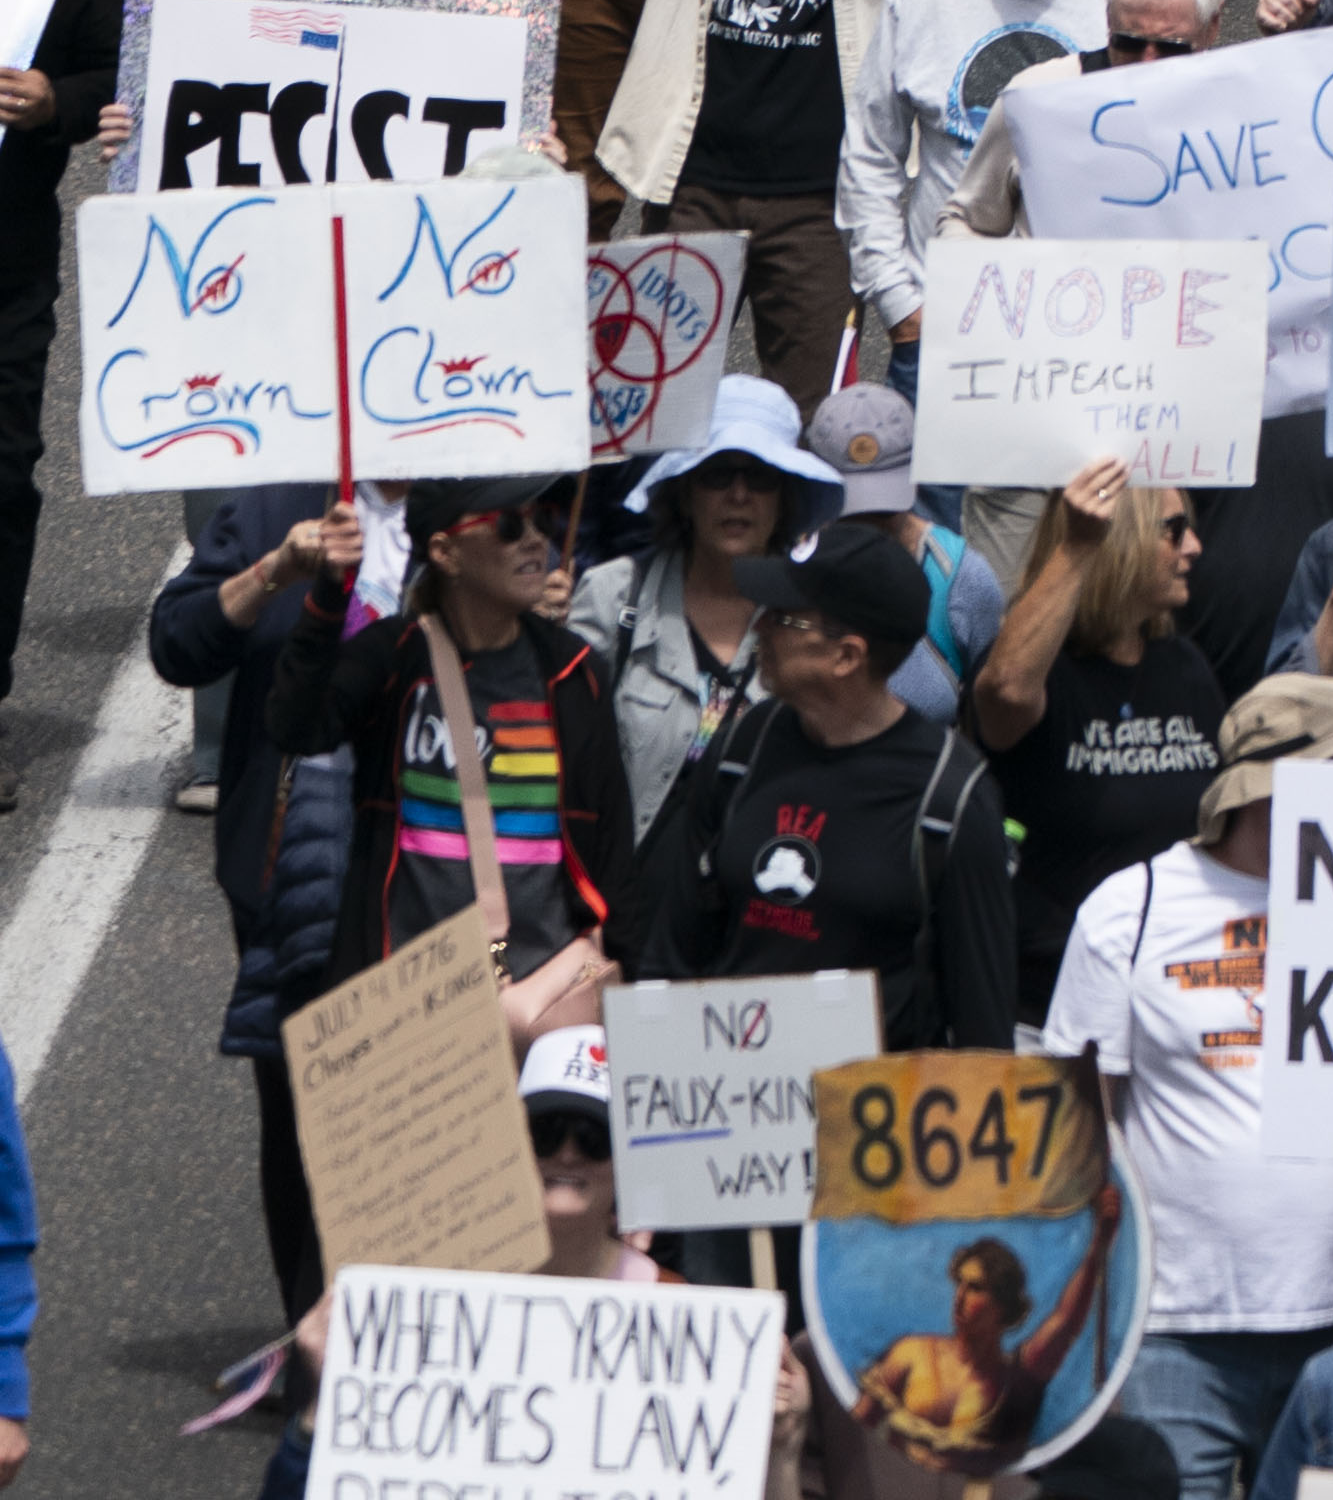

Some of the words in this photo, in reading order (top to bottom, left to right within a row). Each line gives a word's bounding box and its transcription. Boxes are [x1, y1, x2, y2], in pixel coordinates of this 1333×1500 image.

[959, 264, 1228, 346] NOPE
[950, 358, 1155, 401] IMPEACH
[1085, 401, 1179, 430] THEM
[1128, 440, 1236, 481] ALL!
[850, 1083, 1063, 1189] 8647
